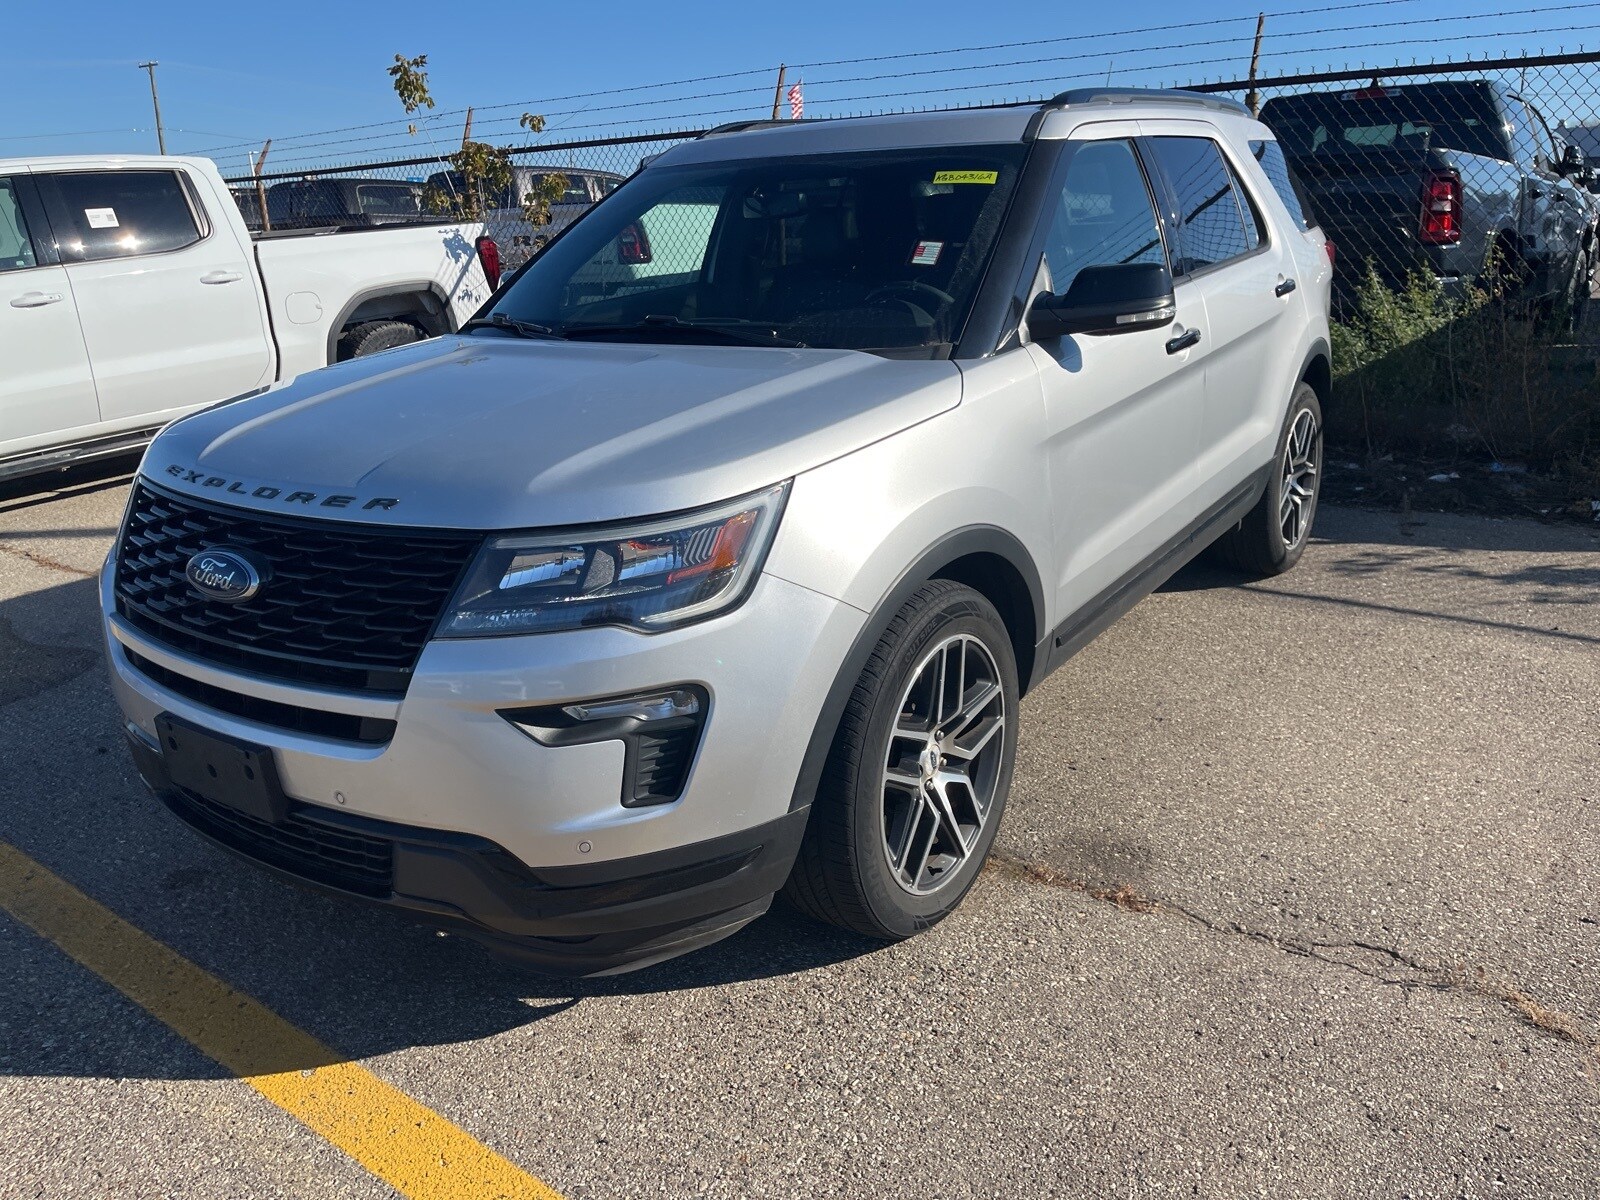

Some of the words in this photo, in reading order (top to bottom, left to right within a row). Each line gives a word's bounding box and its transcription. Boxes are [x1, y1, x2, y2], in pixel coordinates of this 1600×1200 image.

[165, 464, 400, 510] EXPLORER
[195, 557, 236, 591] Ford
[905, 618, 937, 664] OUTSIDE
